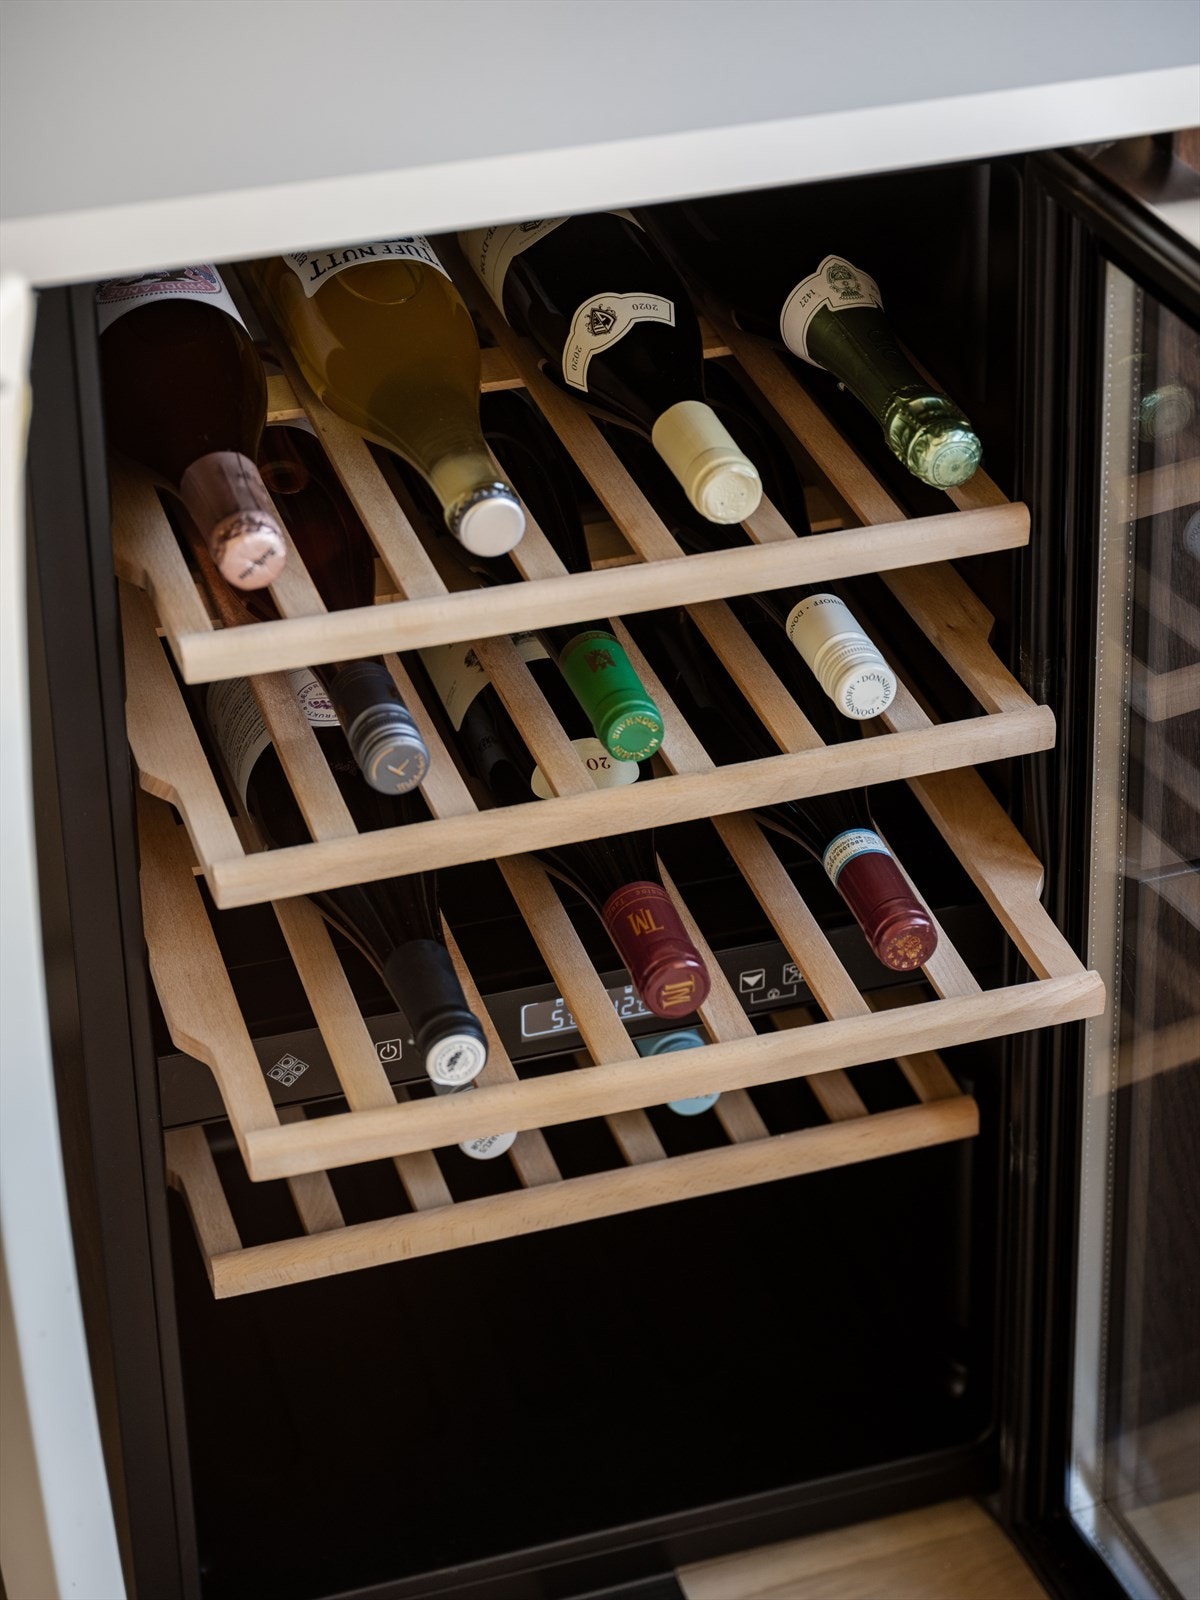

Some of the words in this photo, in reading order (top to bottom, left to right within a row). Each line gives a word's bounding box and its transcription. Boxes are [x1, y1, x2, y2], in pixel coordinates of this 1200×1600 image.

[310, 246, 377, 282] NUTT
[382, 244, 442, 268] TUFF
[632, 303, 659, 312] 2020
[799, 289, 816, 308] 1427
[571, 344, 583, 372] 2020
